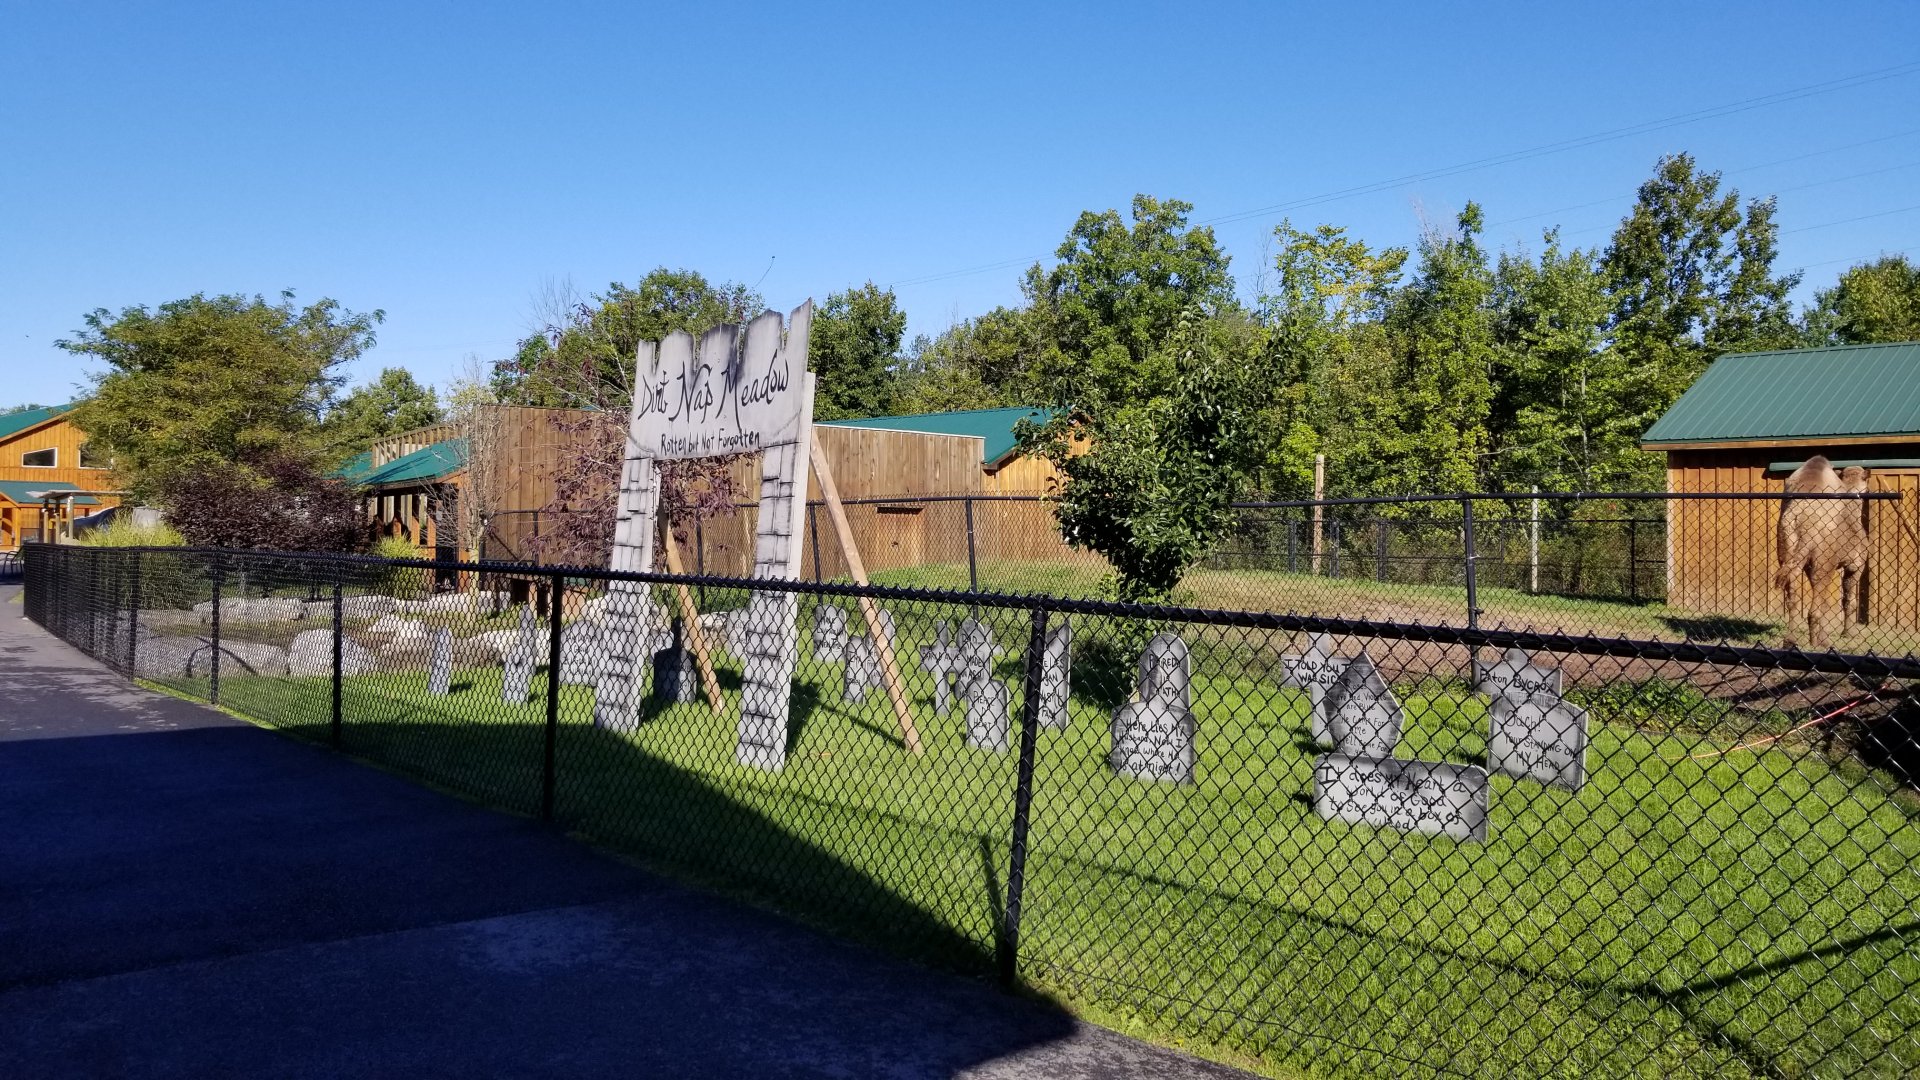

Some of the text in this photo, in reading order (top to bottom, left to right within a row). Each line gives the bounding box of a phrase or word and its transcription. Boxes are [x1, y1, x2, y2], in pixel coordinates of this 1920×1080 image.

[638, 349, 790, 434] Dirt Nap Meadow
[661, 428, 760, 456] Rotten but Not Forgotten
[1284, 659, 1293, 669] I
[1295, 660, 1318, 670] TOLD
[1320, 662, 1339, 673] YOU
[1319, 673, 1338, 685] SIC
[1175, 738, 1182, 748] I
[1131, 760, 1143, 771] at
[1319, 766, 1342, 784] It
[1349, 766, 1382, 784] does
[1452, 783, 1467, 793] a
[1390, 792, 1406, 802] of
[1410, 794, 1447, 807] Good
[1418, 809, 1442, 822] box
